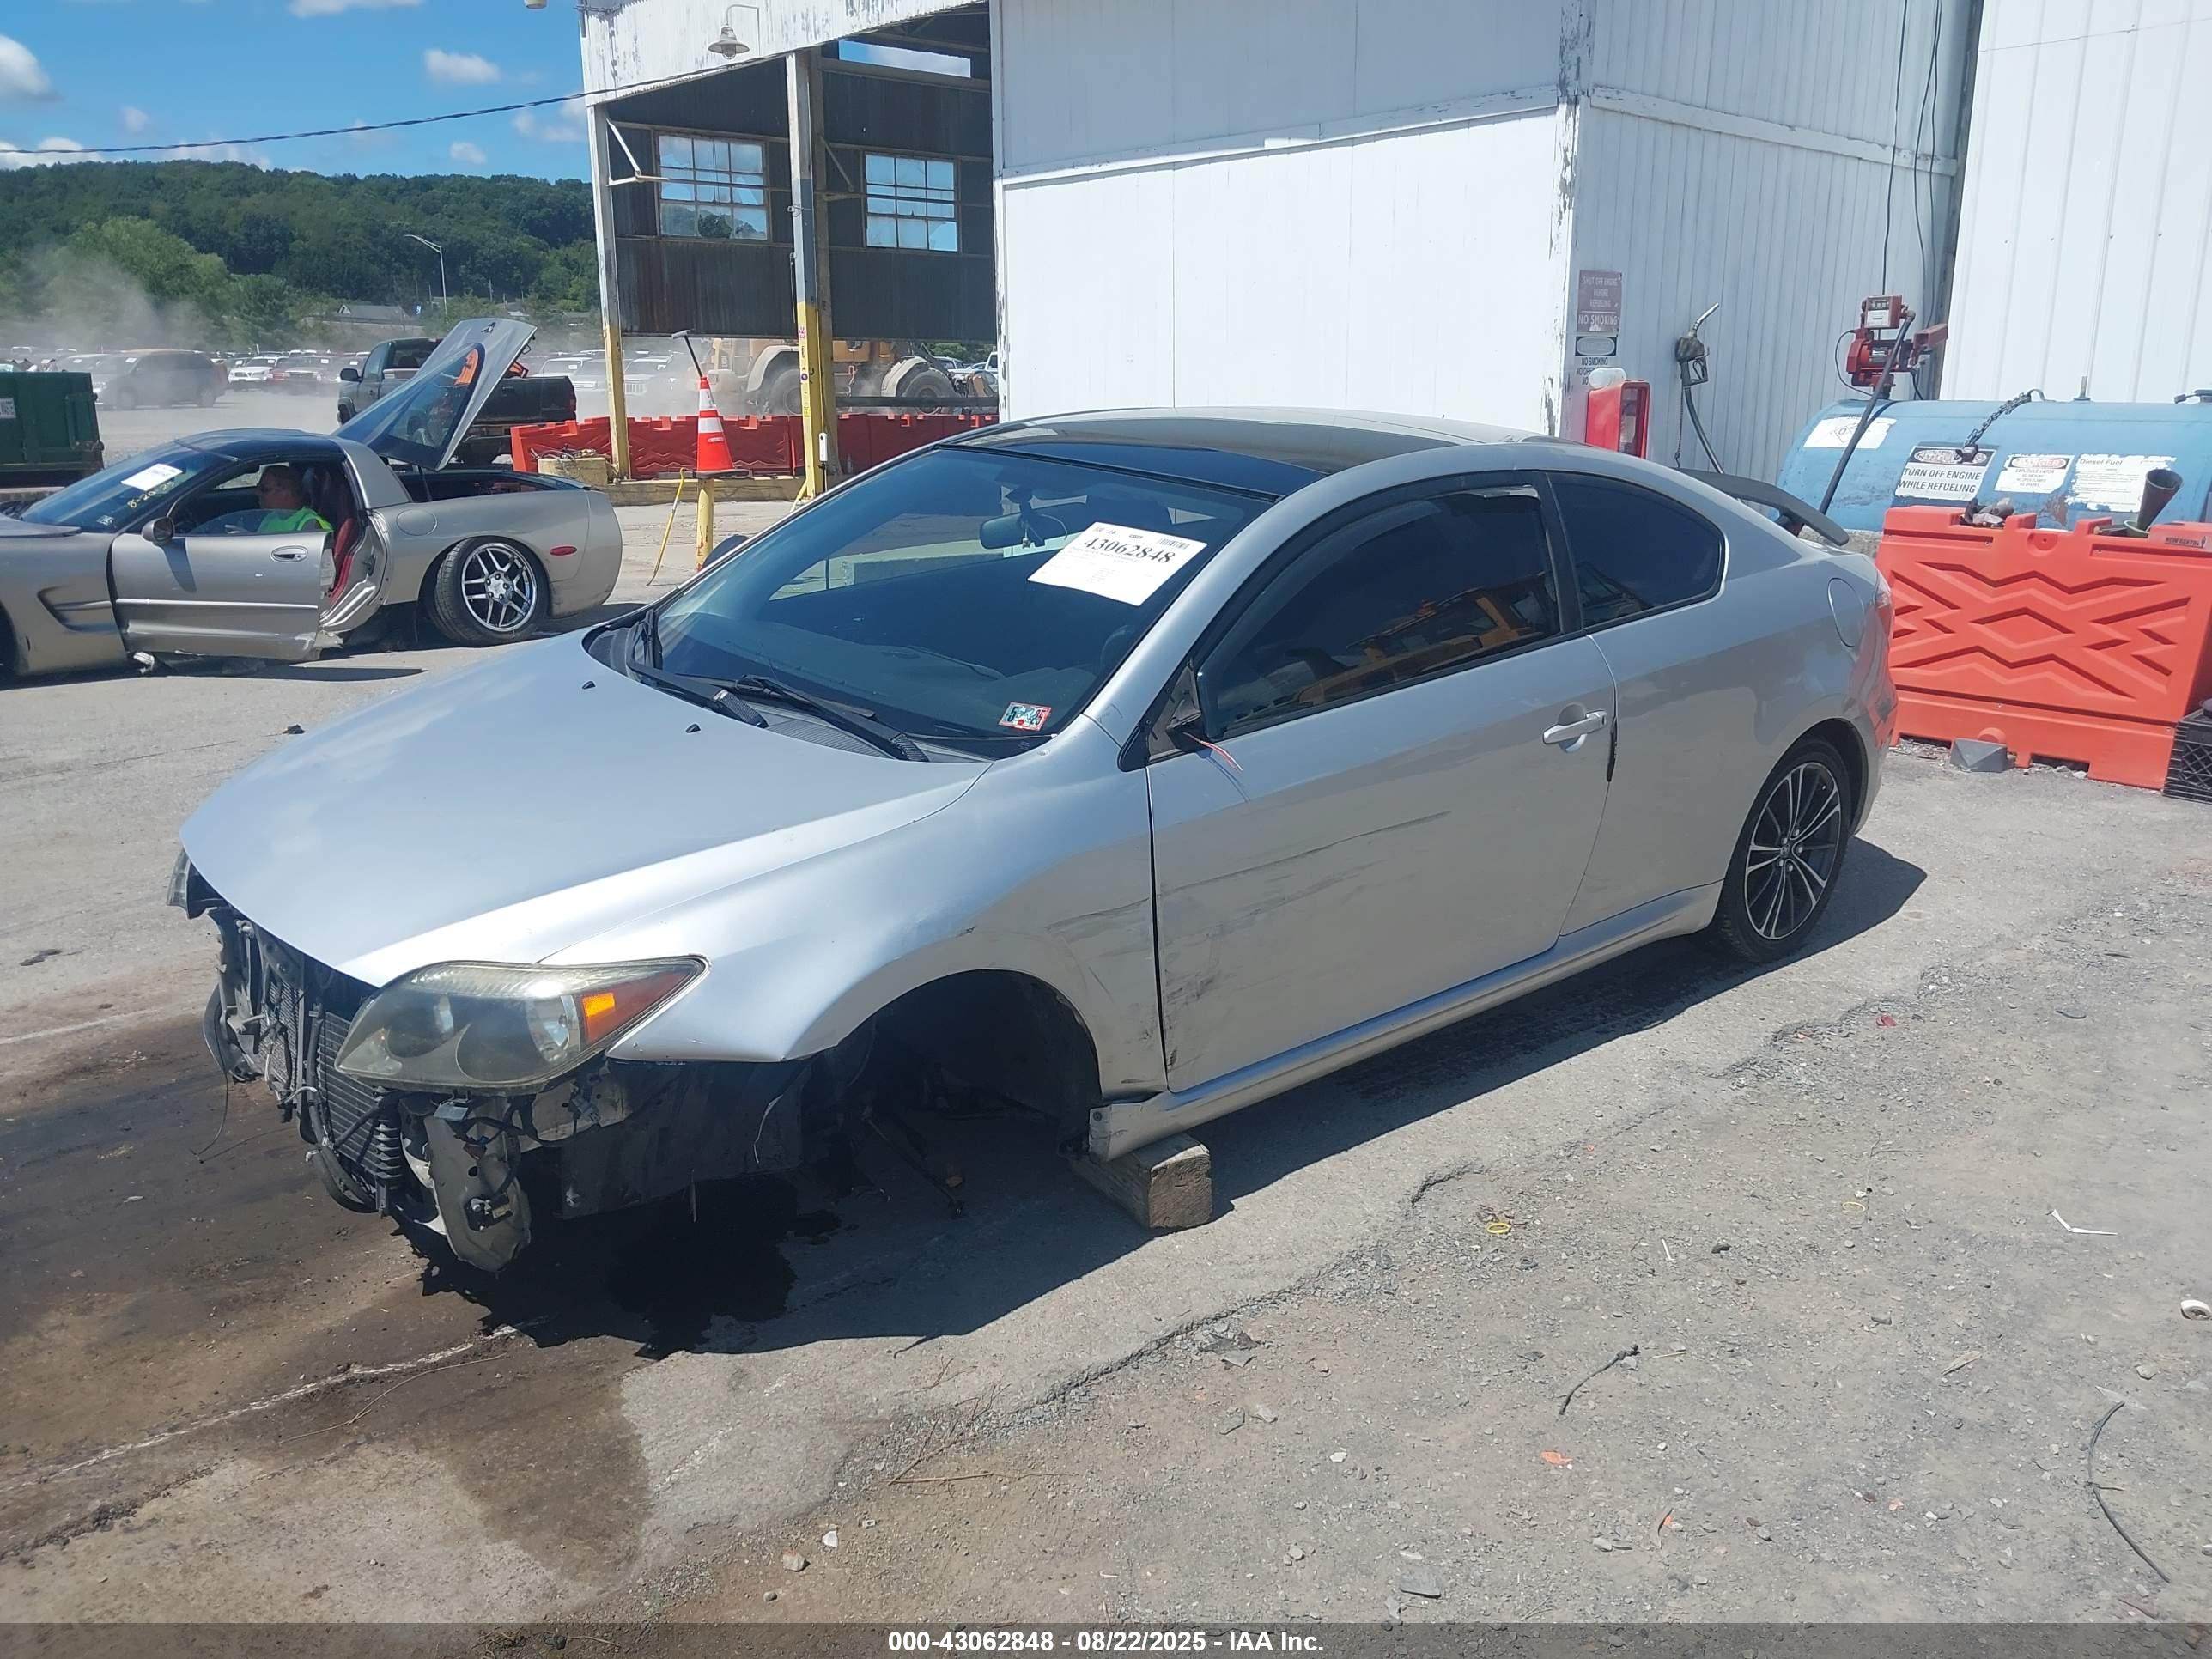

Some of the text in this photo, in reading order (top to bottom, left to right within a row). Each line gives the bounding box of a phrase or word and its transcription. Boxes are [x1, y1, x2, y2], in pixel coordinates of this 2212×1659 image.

[1578, 314, 1619, 325] NO SMOKING
[1581, 357, 1608, 366] NO SMOKING
[1581, 376, 1589, 386] NO
[1904, 467, 1982, 481] TURN OFF ENGINE
[1898, 480, 1977, 494] WHILE REFUELING
[1084, 538, 1176, 564] 43062848
